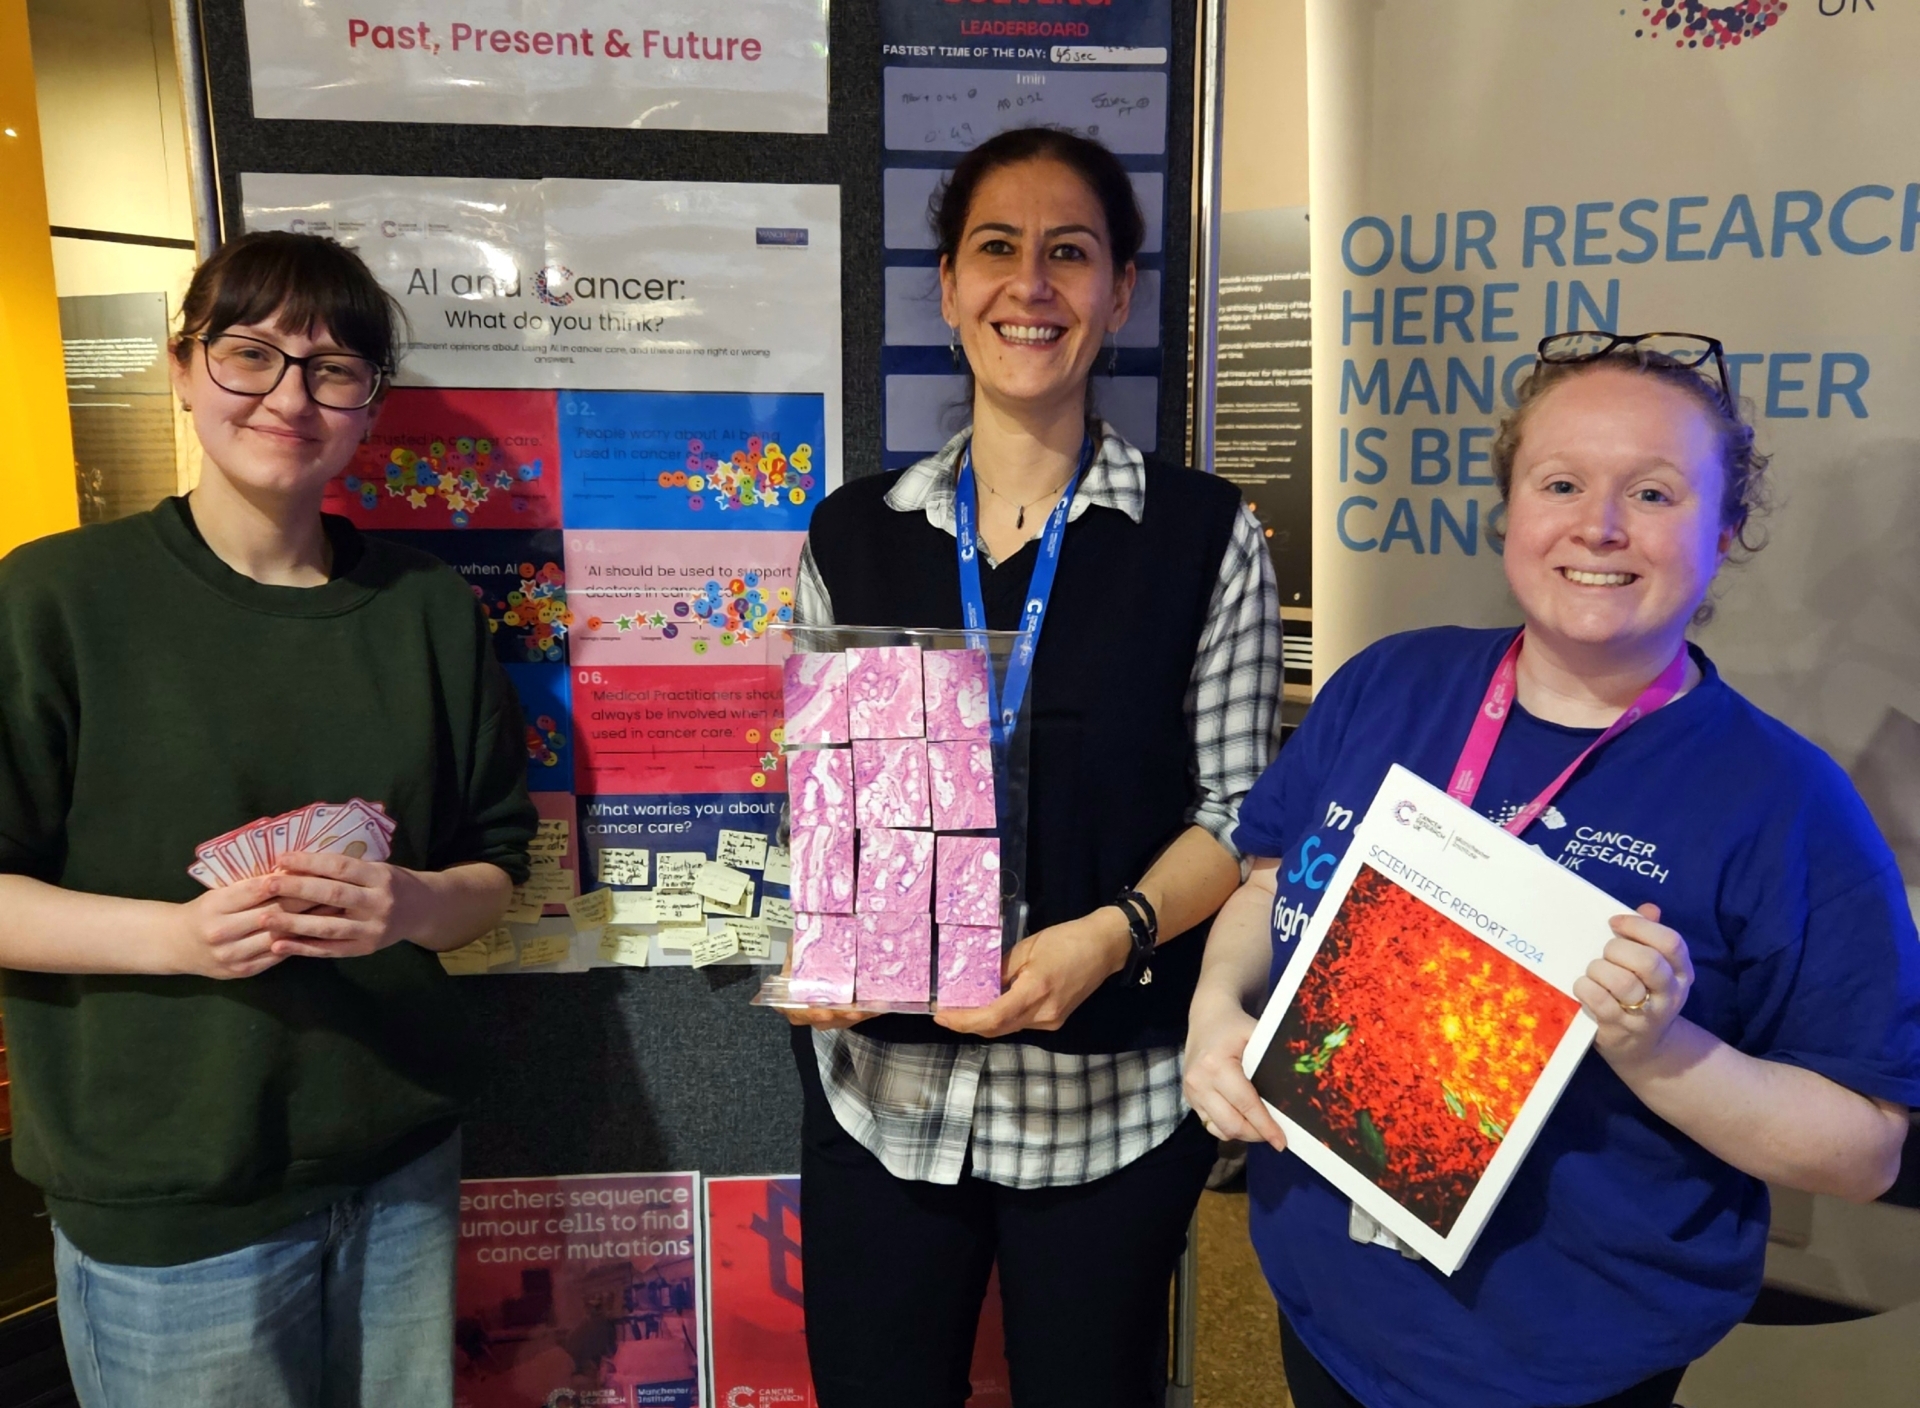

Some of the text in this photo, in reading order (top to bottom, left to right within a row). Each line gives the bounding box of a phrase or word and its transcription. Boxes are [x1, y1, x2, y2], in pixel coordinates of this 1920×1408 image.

[960, 20, 1090, 37] LEADERBOARD
[348, 19, 763, 62] Past, Present & Future
[882, 44, 1047, 60] FASTEST TIME OF THE DAY:
[1341, 210, 1498, 277] OUR
[406, 264, 686, 307] AI and Cancer:
[1342, 279, 1620, 347] HERE IN
[445, 311, 665, 336] What do you think?
[450, 342, 490, 353] opinions
[492, 343, 519, 353] about
[570, 345, 602, 354] cancer
[741, 348, 771, 359] wrong
[565, 401, 596, 416] 02.
[573, 426, 626, 442] 'People
[629, 430, 671, 445] worry
[674, 427, 718, 441] about
[721, 429, 736, 441] AI
[573, 446, 611, 460] used
[613, 446, 627, 460] in
[630, 449, 681, 461] cancer
[1339, 427, 1388, 485] IS
[1336, 495, 1508, 557] CAN
[571, 539, 603, 554] 04.
[460, 562, 519, 575] when AI
[585, 564, 793, 580] 'AI should be used to support
[585, 584, 647, 599] doctors
[577, 671, 609, 685] 06.
[591, 689, 651, 702] 'Medical
[653, 688, 742, 702] Practitioners
[591, 708, 641, 724] always
[645, 709, 664, 721] be
[667, 707, 727, 720] involved
[730, 709, 769, 720] when
[591, 726, 628, 740] used
[631, 727, 644, 739] in
[647, 727, 697, 739] cancer
[585, 801, 776, 819] What worries you about
[585, 820, 693, 835] cancer care?
[1575, 826, 1657, 859] CANCER
[1287, 835, 1338, 892] Sc
[1556, 853, 1587, 871] UK
[1564, 839, 1670, 885] RESEARCH
[1368, 844, 1545, 965] SCIENTIFIC REPORT 2024
[460, 1186, 689, 1211] earchers sequence
[460, 1208, 689, 1238] umour cells to find
[476, 1237, 691, 1264] cancer mutations
[637, 1386, 690, 1397] Manchester
[758, 1388, 795, 1396] CANCER
